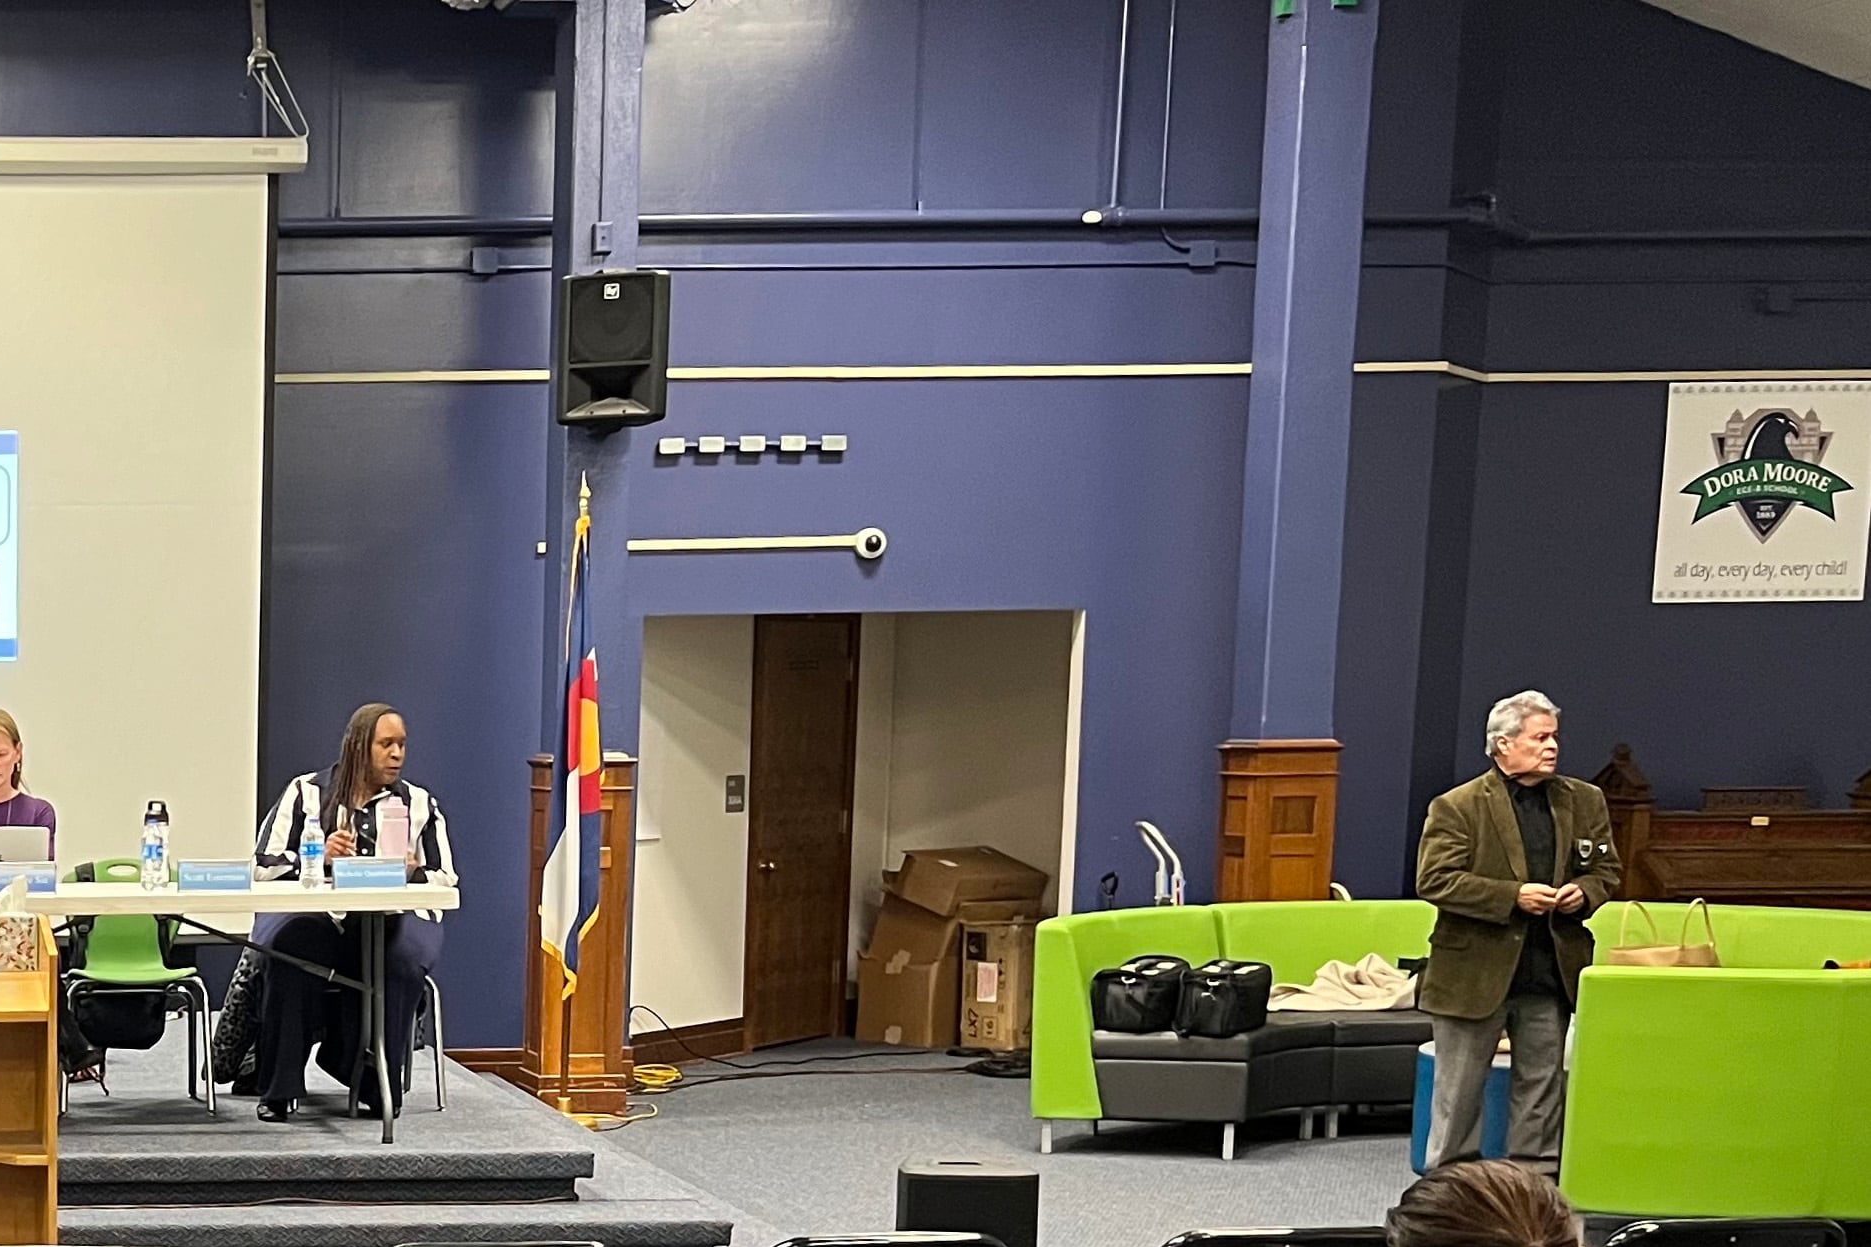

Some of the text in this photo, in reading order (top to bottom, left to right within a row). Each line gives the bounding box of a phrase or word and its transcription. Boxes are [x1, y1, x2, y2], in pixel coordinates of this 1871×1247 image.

[1703, 463, 1832, 497] DORA MOORE
[1673, 562, 1688, 578] all
[1718, 564, 1751, 582] every
[1780, 564, 1813, 581] every
